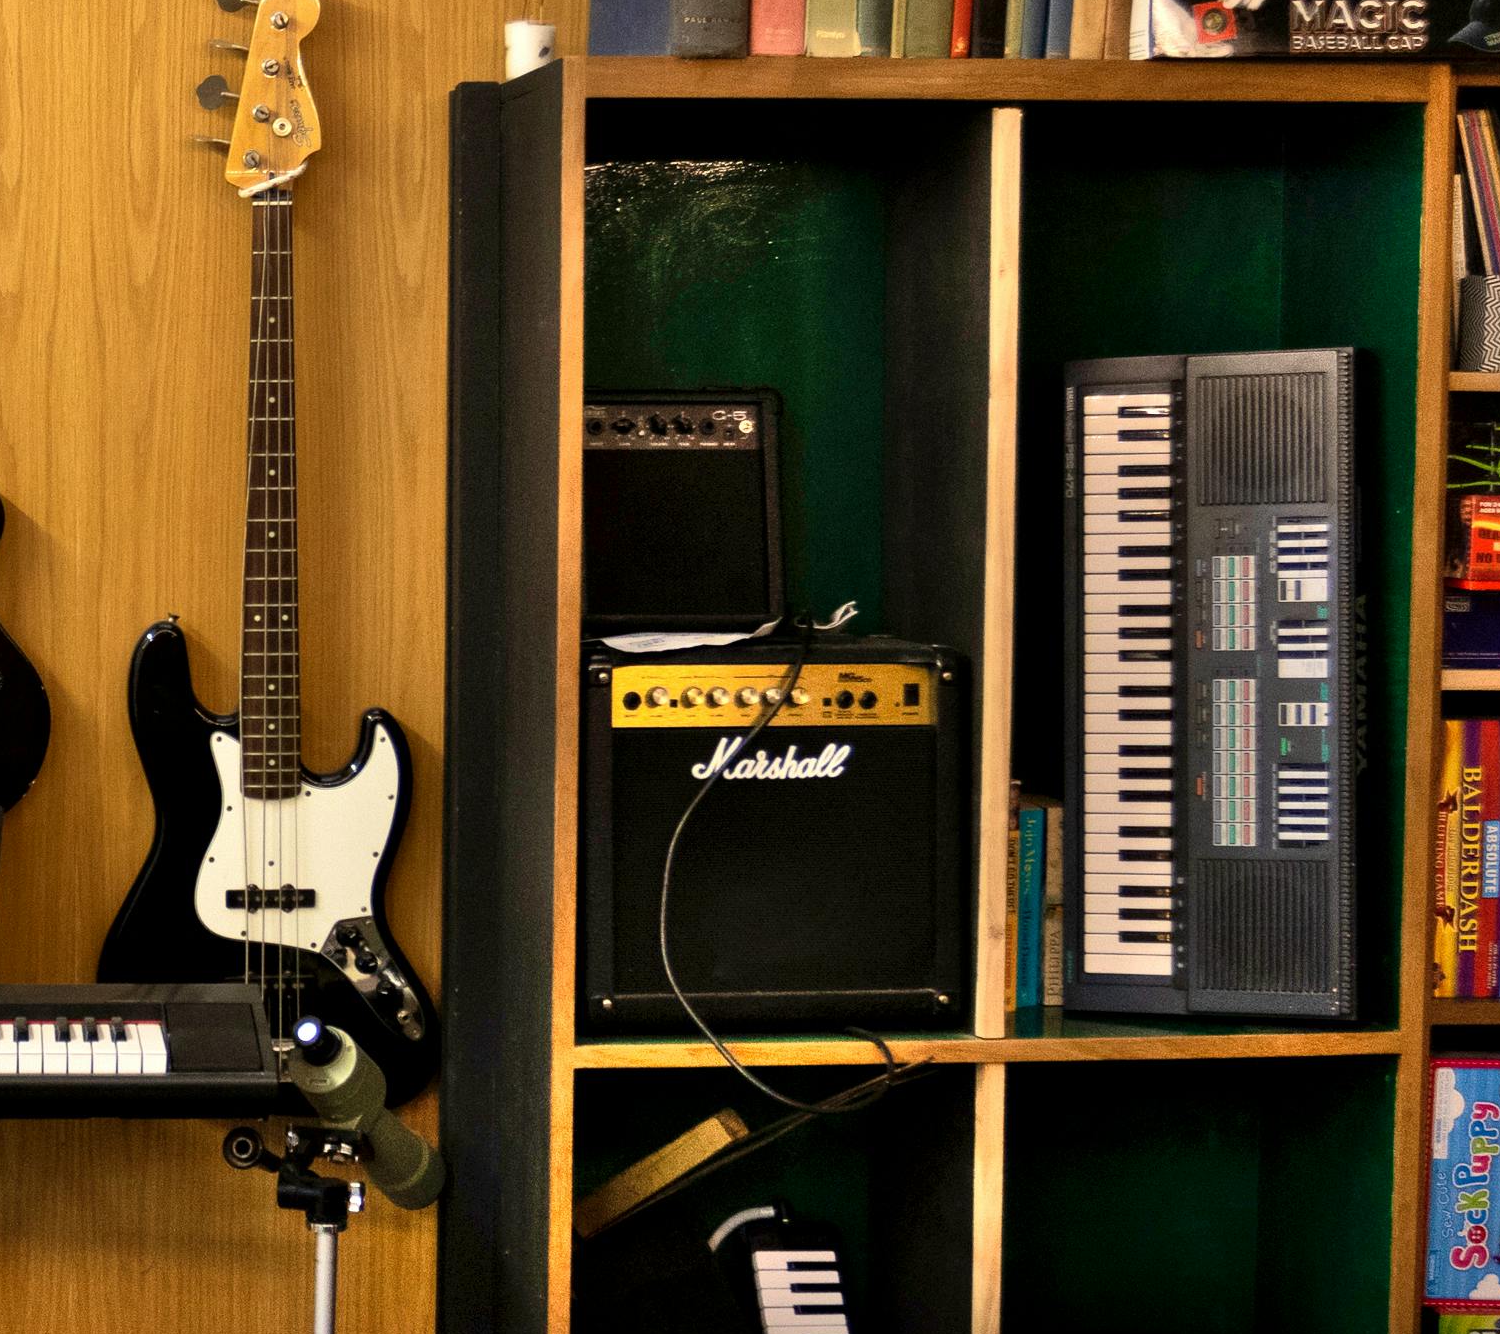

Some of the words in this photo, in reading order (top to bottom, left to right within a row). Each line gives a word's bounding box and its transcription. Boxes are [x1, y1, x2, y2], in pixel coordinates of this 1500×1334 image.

[1291, 34, 1384, 52] BASEBALL
[1386, 34, 1426, 52] CAP
[690, 736, 852, 780] Marshall
[1458, 765, 1483, 953] BALDERDASH
[1485, 824, 1499, 894] ABSOLUTE
